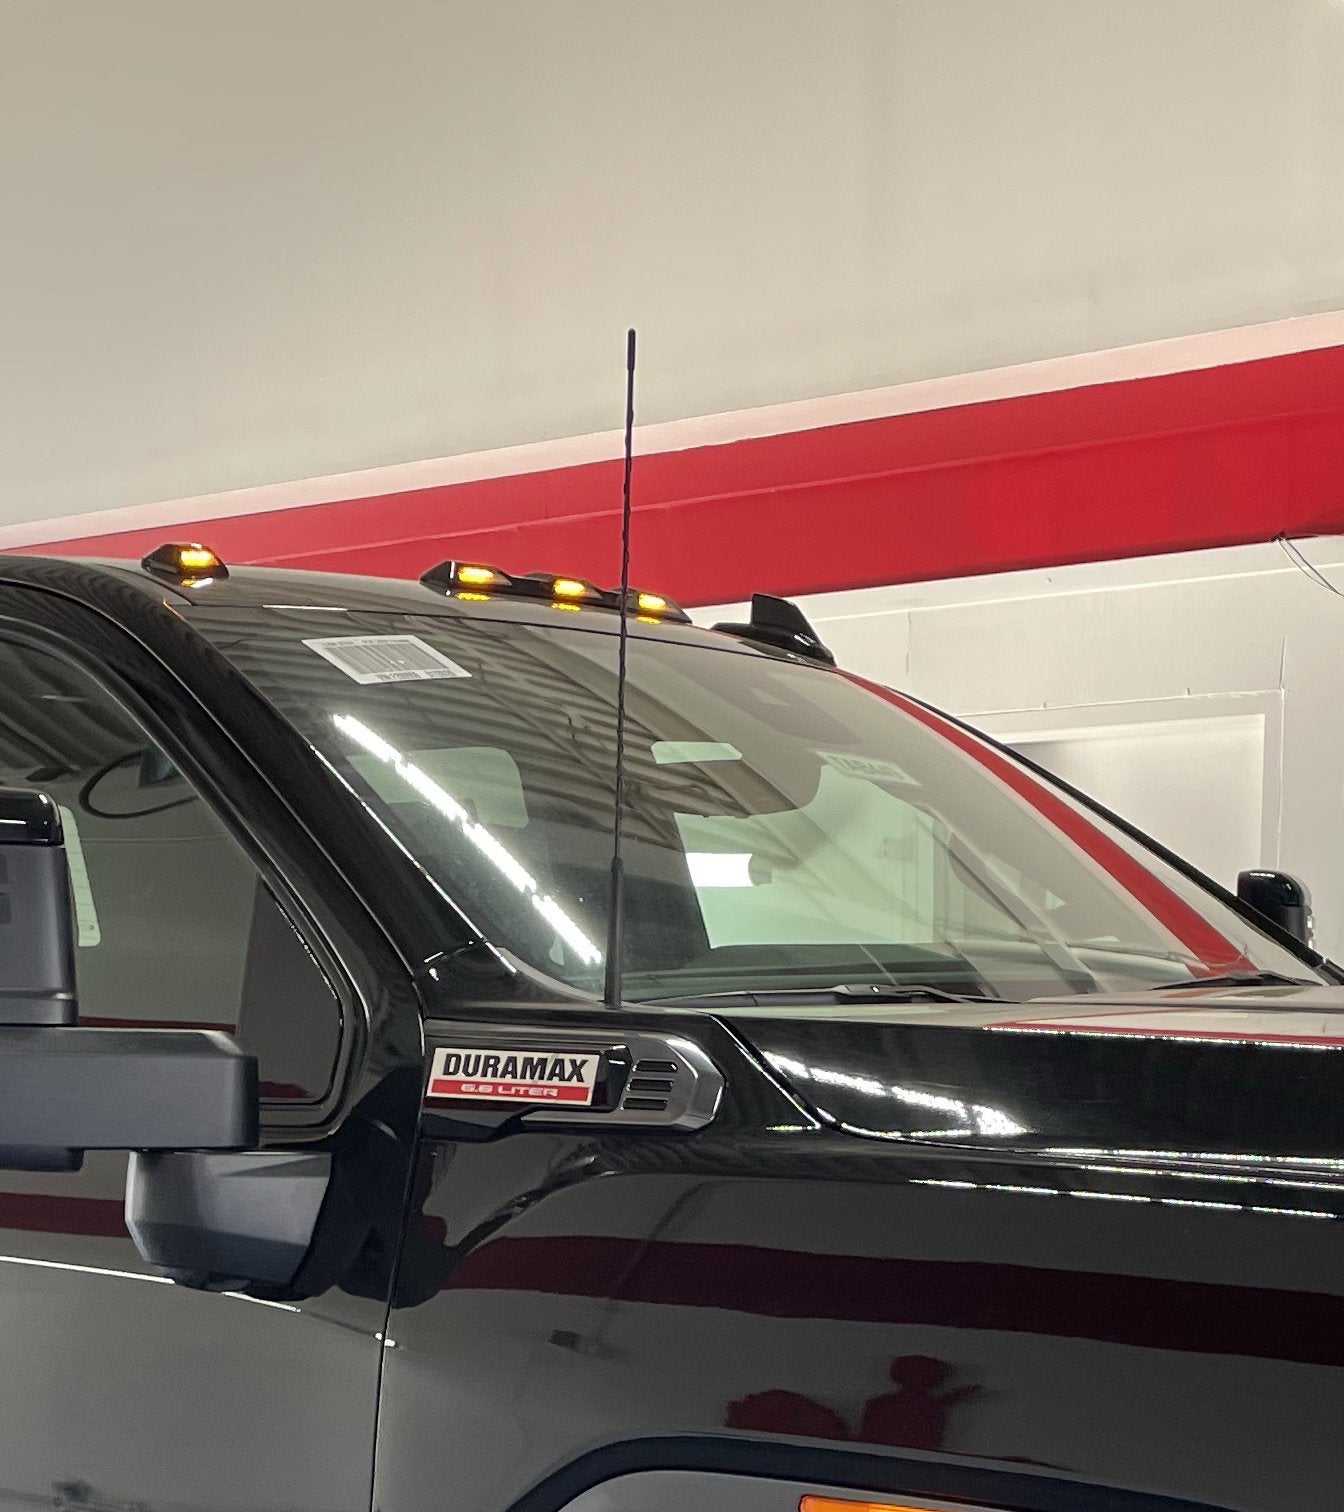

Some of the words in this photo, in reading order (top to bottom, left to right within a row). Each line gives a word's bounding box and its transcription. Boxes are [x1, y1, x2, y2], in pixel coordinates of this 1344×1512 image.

[442, 1053, 589, 1083] DURAMAX
[460, 1083, 493, 1093] 6.6
[497, 1085, 558, 1097] LITER
